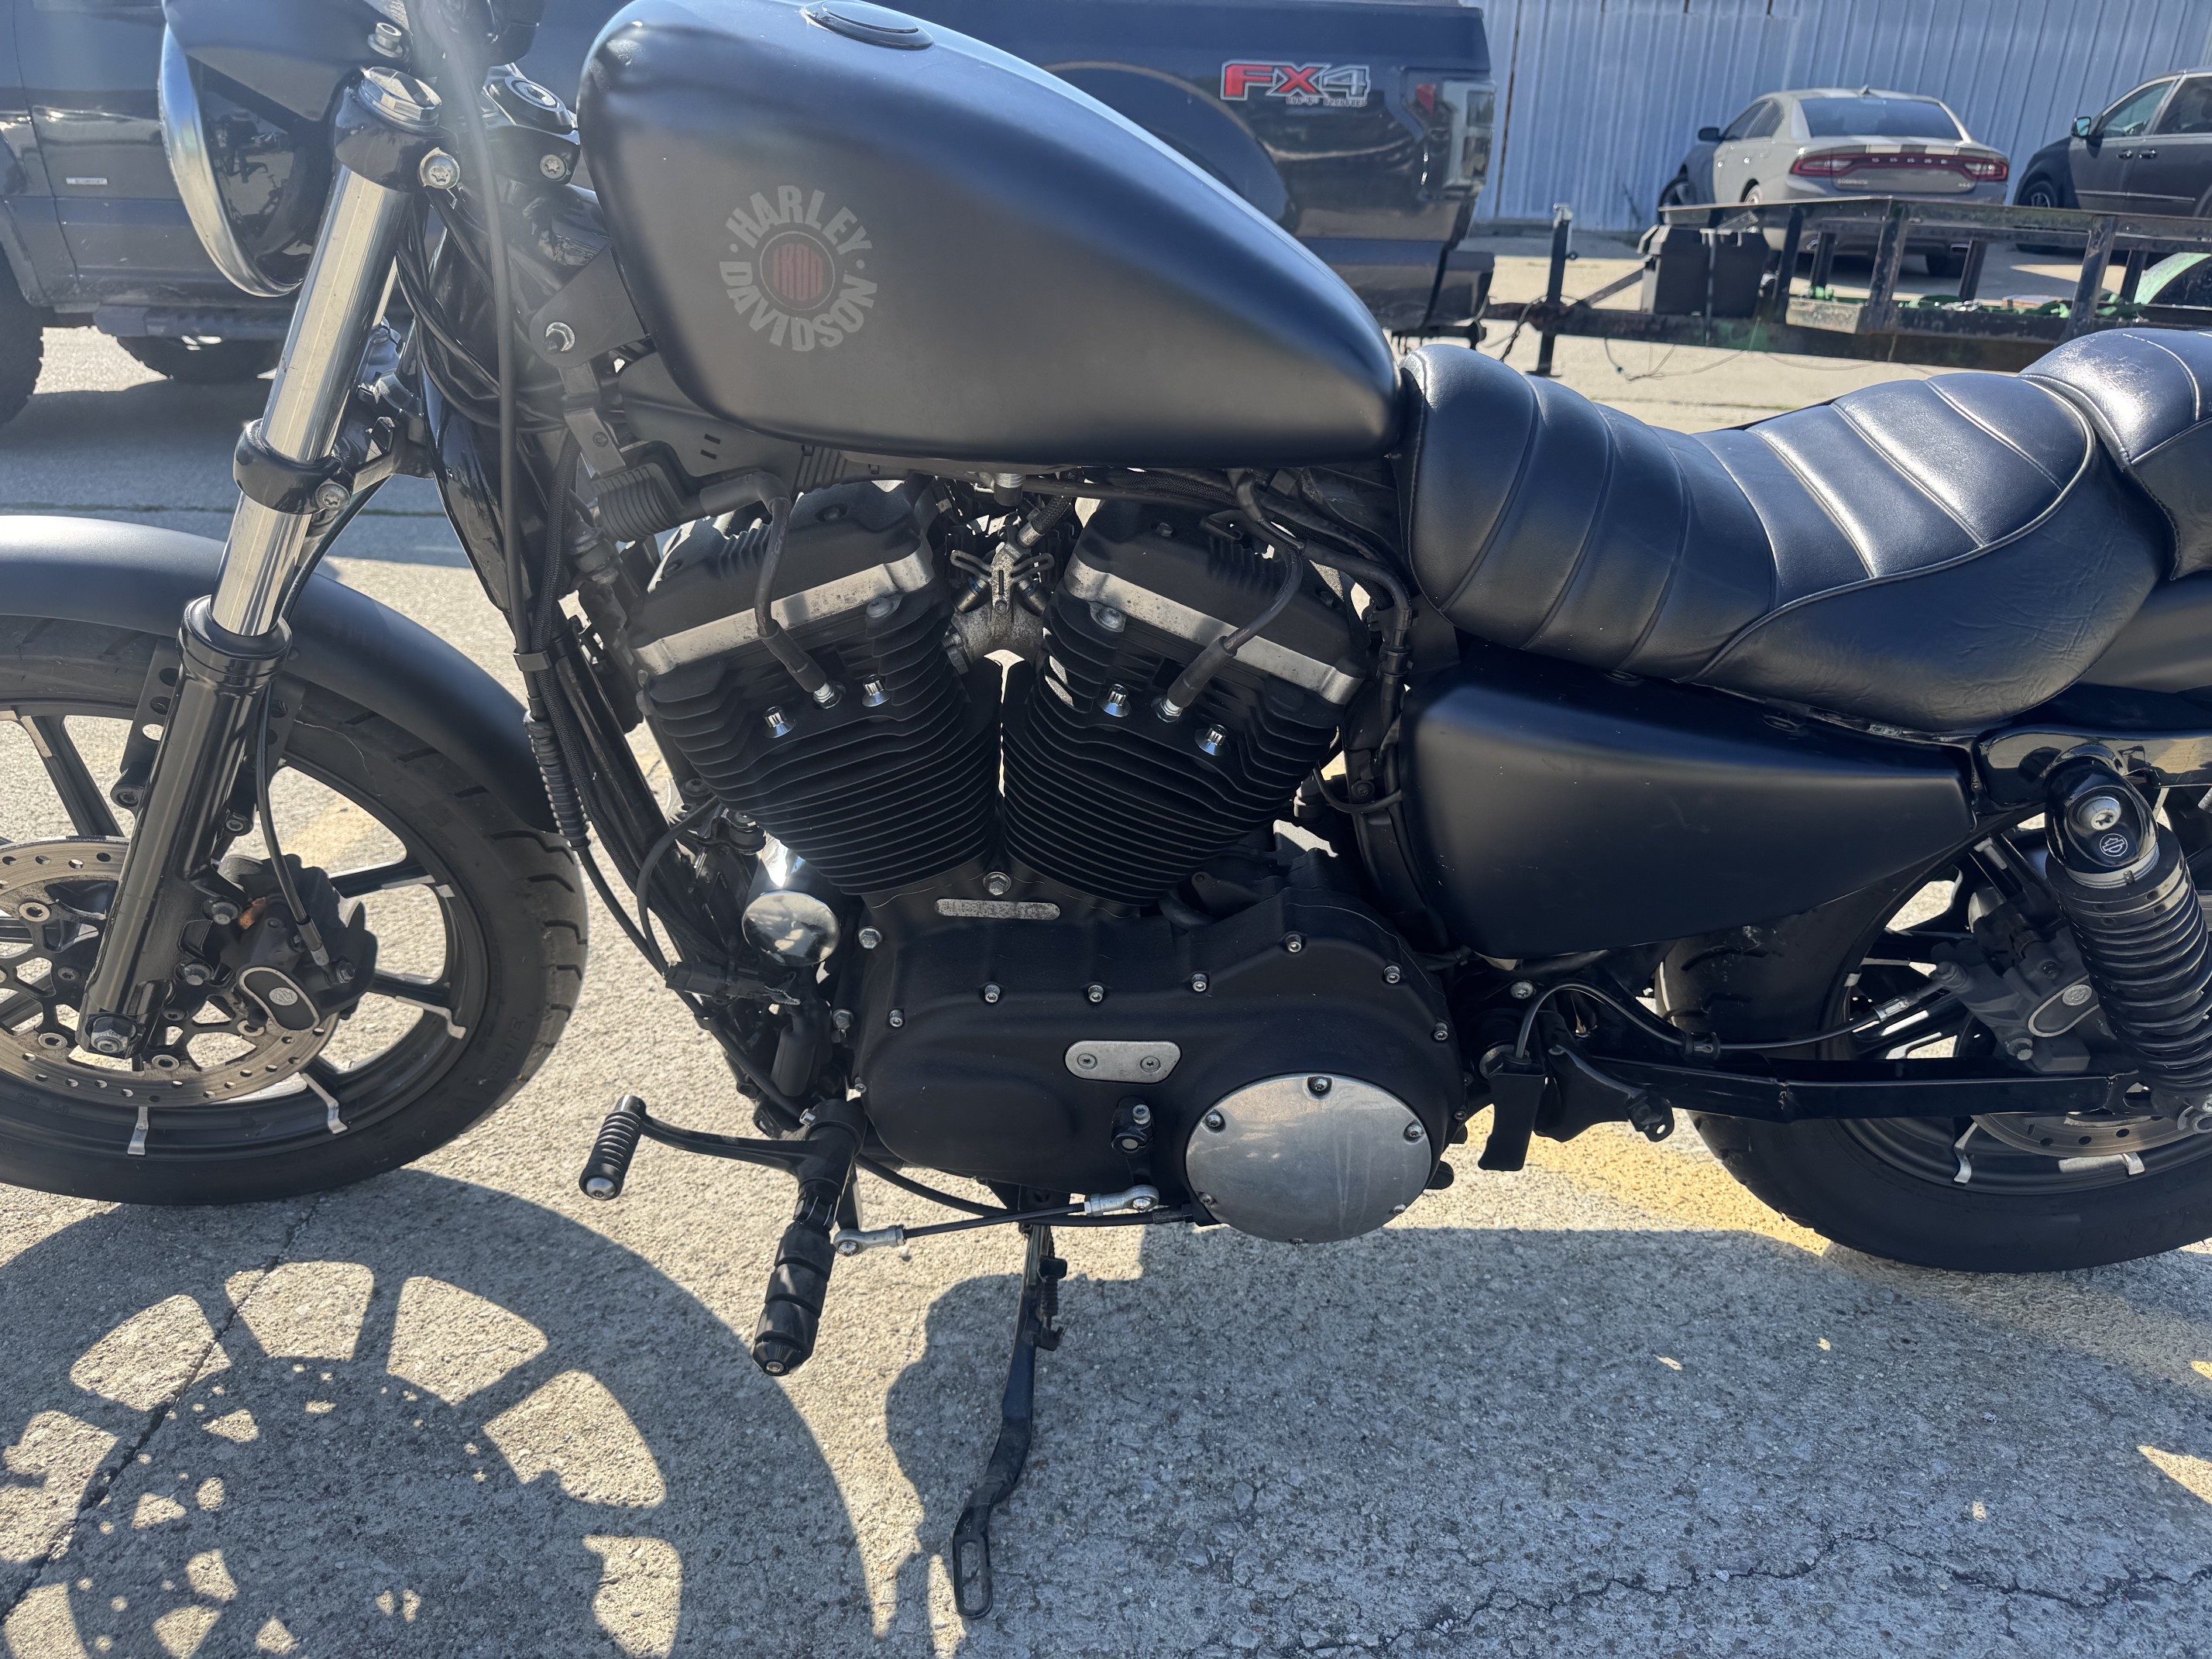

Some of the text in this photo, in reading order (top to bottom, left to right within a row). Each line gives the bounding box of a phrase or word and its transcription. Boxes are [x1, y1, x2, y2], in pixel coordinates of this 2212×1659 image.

[1221, 60, 1370, 101] FX4
[726, 185, 873, 255] HARLEY
[720, 261, 878, 352] DAVIDSON
